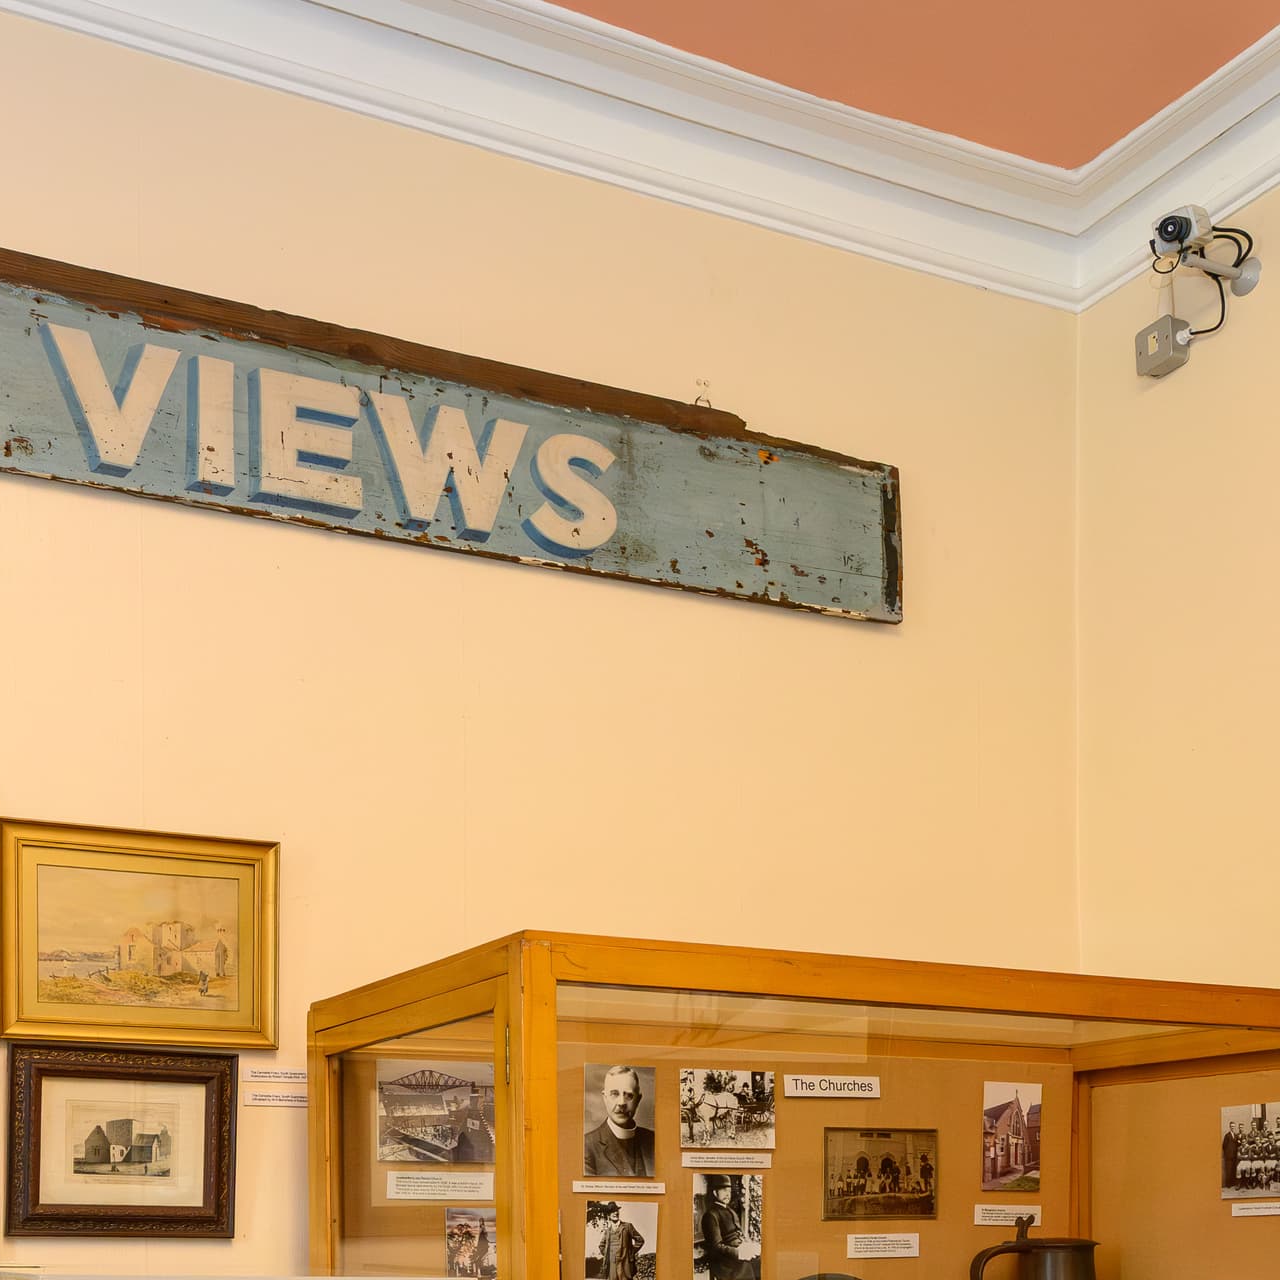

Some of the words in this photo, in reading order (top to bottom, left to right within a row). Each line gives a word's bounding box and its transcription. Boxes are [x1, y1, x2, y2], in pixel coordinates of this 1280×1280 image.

[38, 322, 618, 558] VIEWS
[792, 1078, 816, 1092] The
[818, 1078, 874, 1093] Churches
